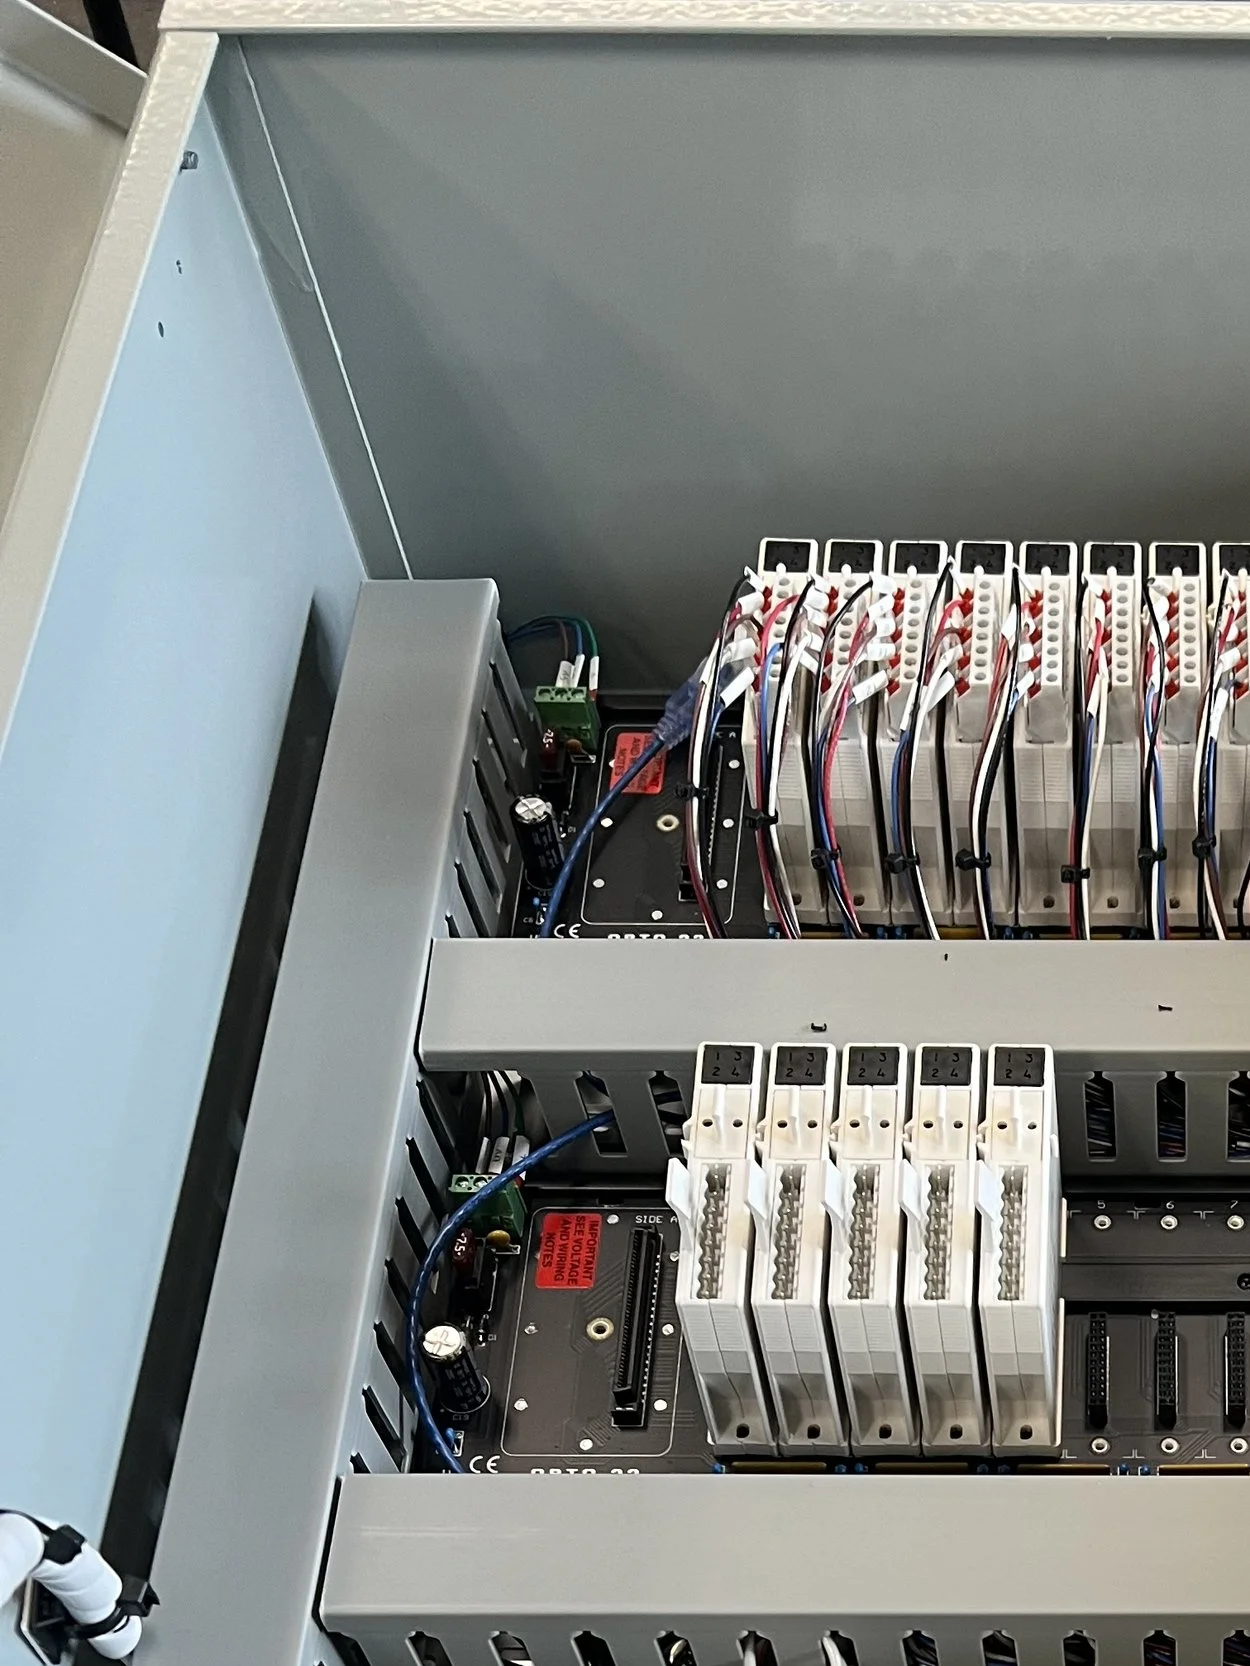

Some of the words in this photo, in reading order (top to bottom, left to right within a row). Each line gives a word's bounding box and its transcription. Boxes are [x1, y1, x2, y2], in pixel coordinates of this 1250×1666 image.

[734, 1052, 742, 1061] 3
[806, 1052, 815, 1062] 3
[712, 1067, 721, 1077] 2
[731, 1067, 740, 1077] 4
[786, 1068, 794, 1078] 2
[805, 1068, 813, 1078] 4
[560, 1218, 572, 1242] AND
[573, 1215, 585, 1236] SEE
[635, 1215, 663, 1224] SIDE
[670, 1215, 678, 1224] A
[542, 1232, 556, 1268] NOTES
[583, 1220, 599, 1280] IMPORTANT
[554, 1243, 568, 1282] WIRING
[567, 1238, 582, 1286] VOLTAGE
